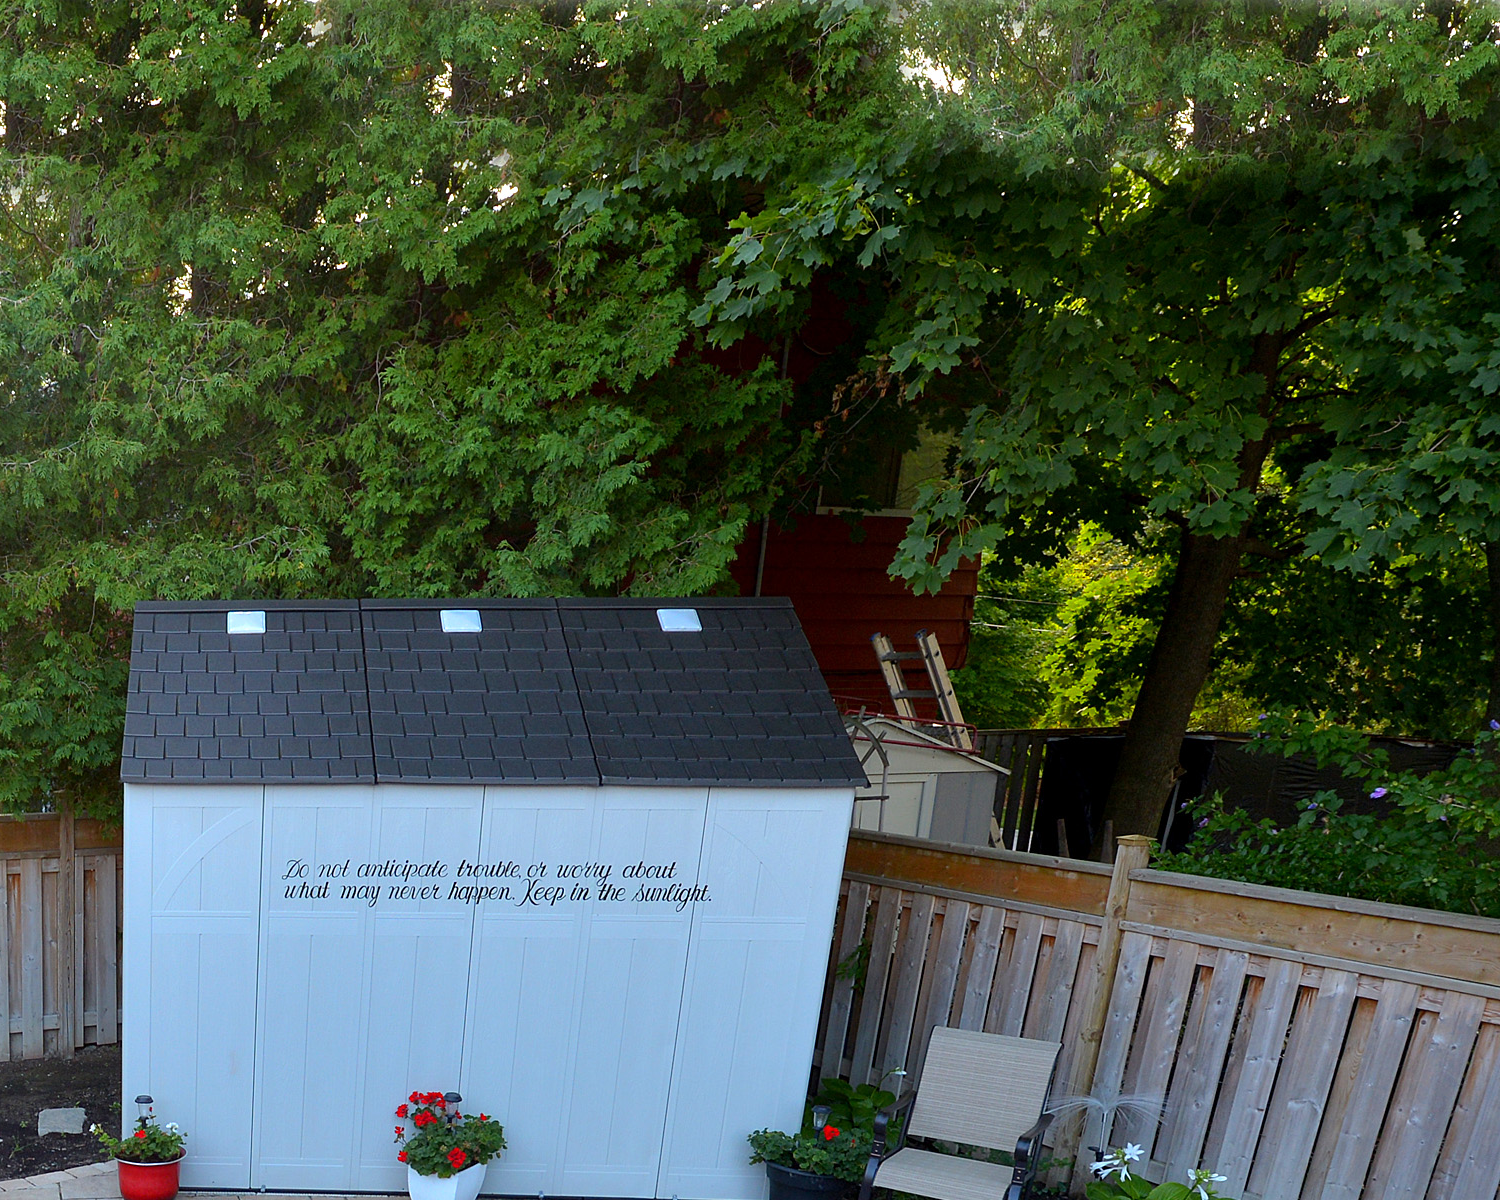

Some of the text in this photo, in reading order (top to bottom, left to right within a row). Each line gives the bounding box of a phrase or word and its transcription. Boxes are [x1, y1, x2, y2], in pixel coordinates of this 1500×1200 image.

[281, 858, 310, 881] Do
[317, 859, 351, 878] not
[356, 859, 449, 883] anticipate
[526, 861, 548, 879] or
[556, 861, 612, 887] worry
[622, 860, 678, 879] about
[284, 881, 331, 900] what
[340, 884, 381, 908] may
[387, 884, 443, 901] never
[447, 882, 516, 905] happen.
[514, 878, 567, 908] Keep
[569, 882, 592, 902] in
[597, 883, 627, 902] the
